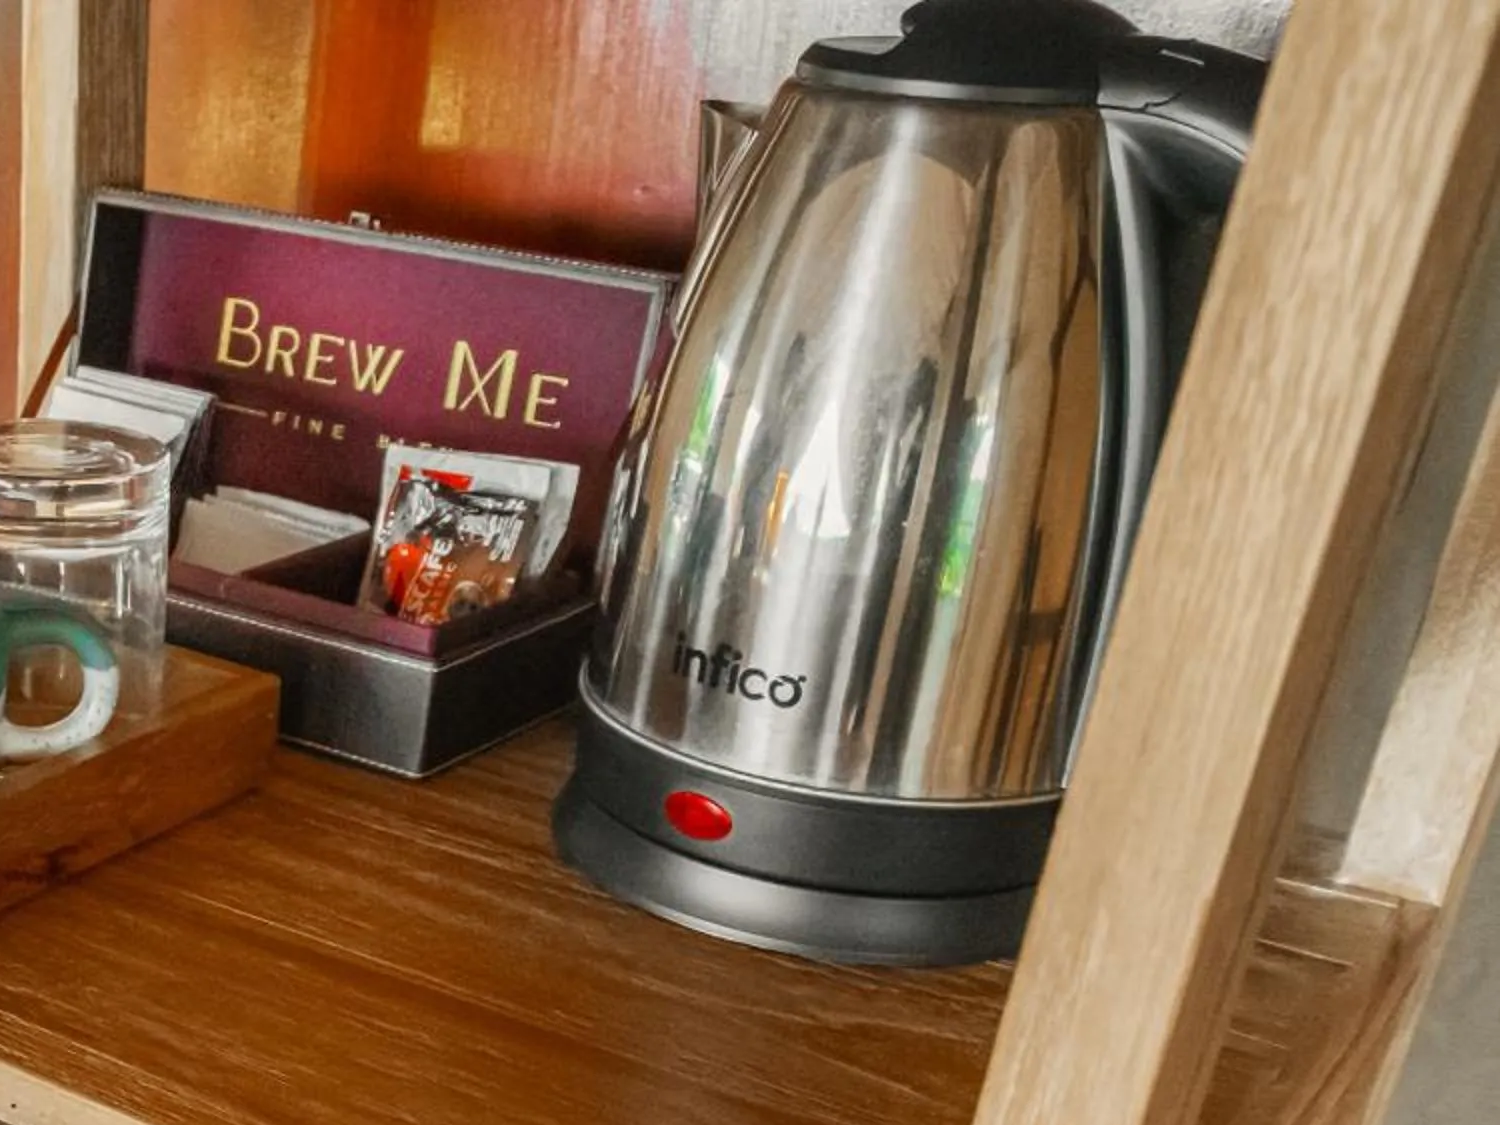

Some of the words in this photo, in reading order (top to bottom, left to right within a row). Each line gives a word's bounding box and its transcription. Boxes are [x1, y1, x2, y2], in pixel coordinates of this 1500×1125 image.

[216, 298, 404, 395] BREW
[443, 340, 570, 429] ME
[271, 410, 346, 440] FINE
